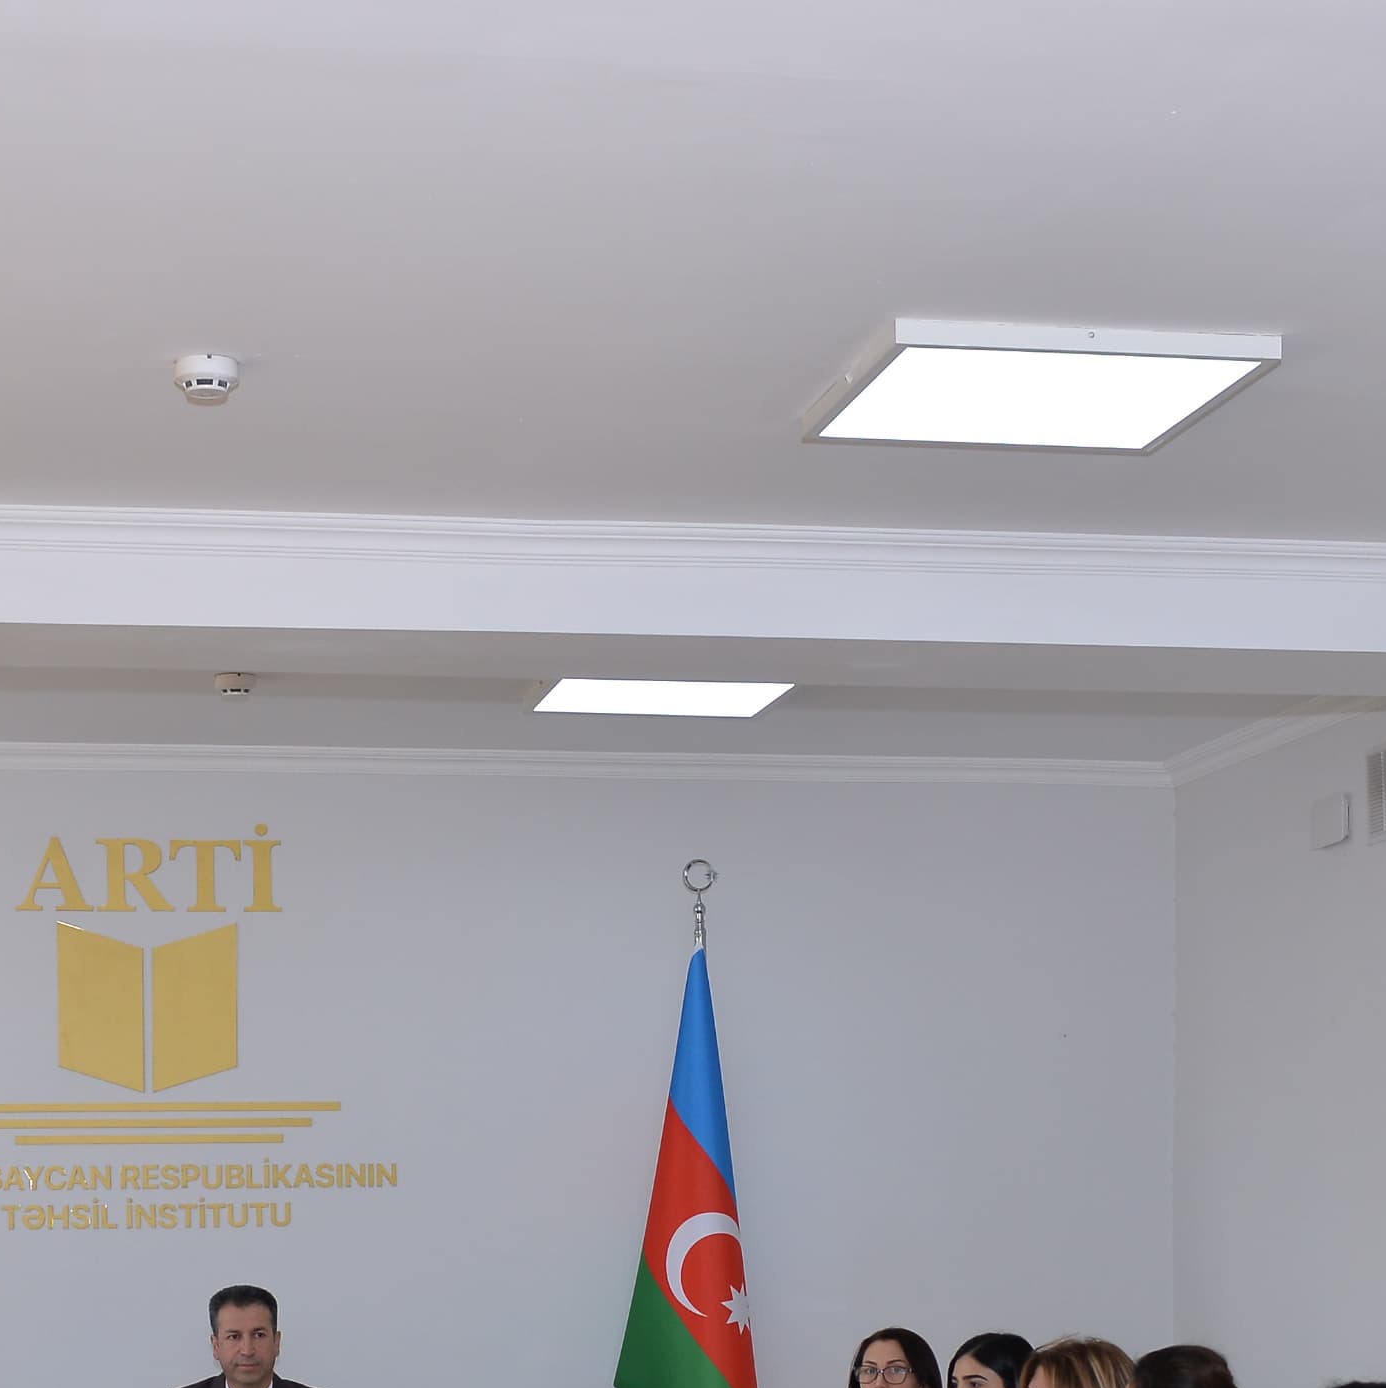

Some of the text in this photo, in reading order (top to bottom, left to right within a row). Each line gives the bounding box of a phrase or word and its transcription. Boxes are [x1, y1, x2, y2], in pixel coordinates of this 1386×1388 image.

[15, 822, 283, 913] ARTİ
[120, 1158, 399, 1191] RESPUBLİKASININ
[1, 1197, 293, 1231] TƏHSİL İNSTİTUTU
